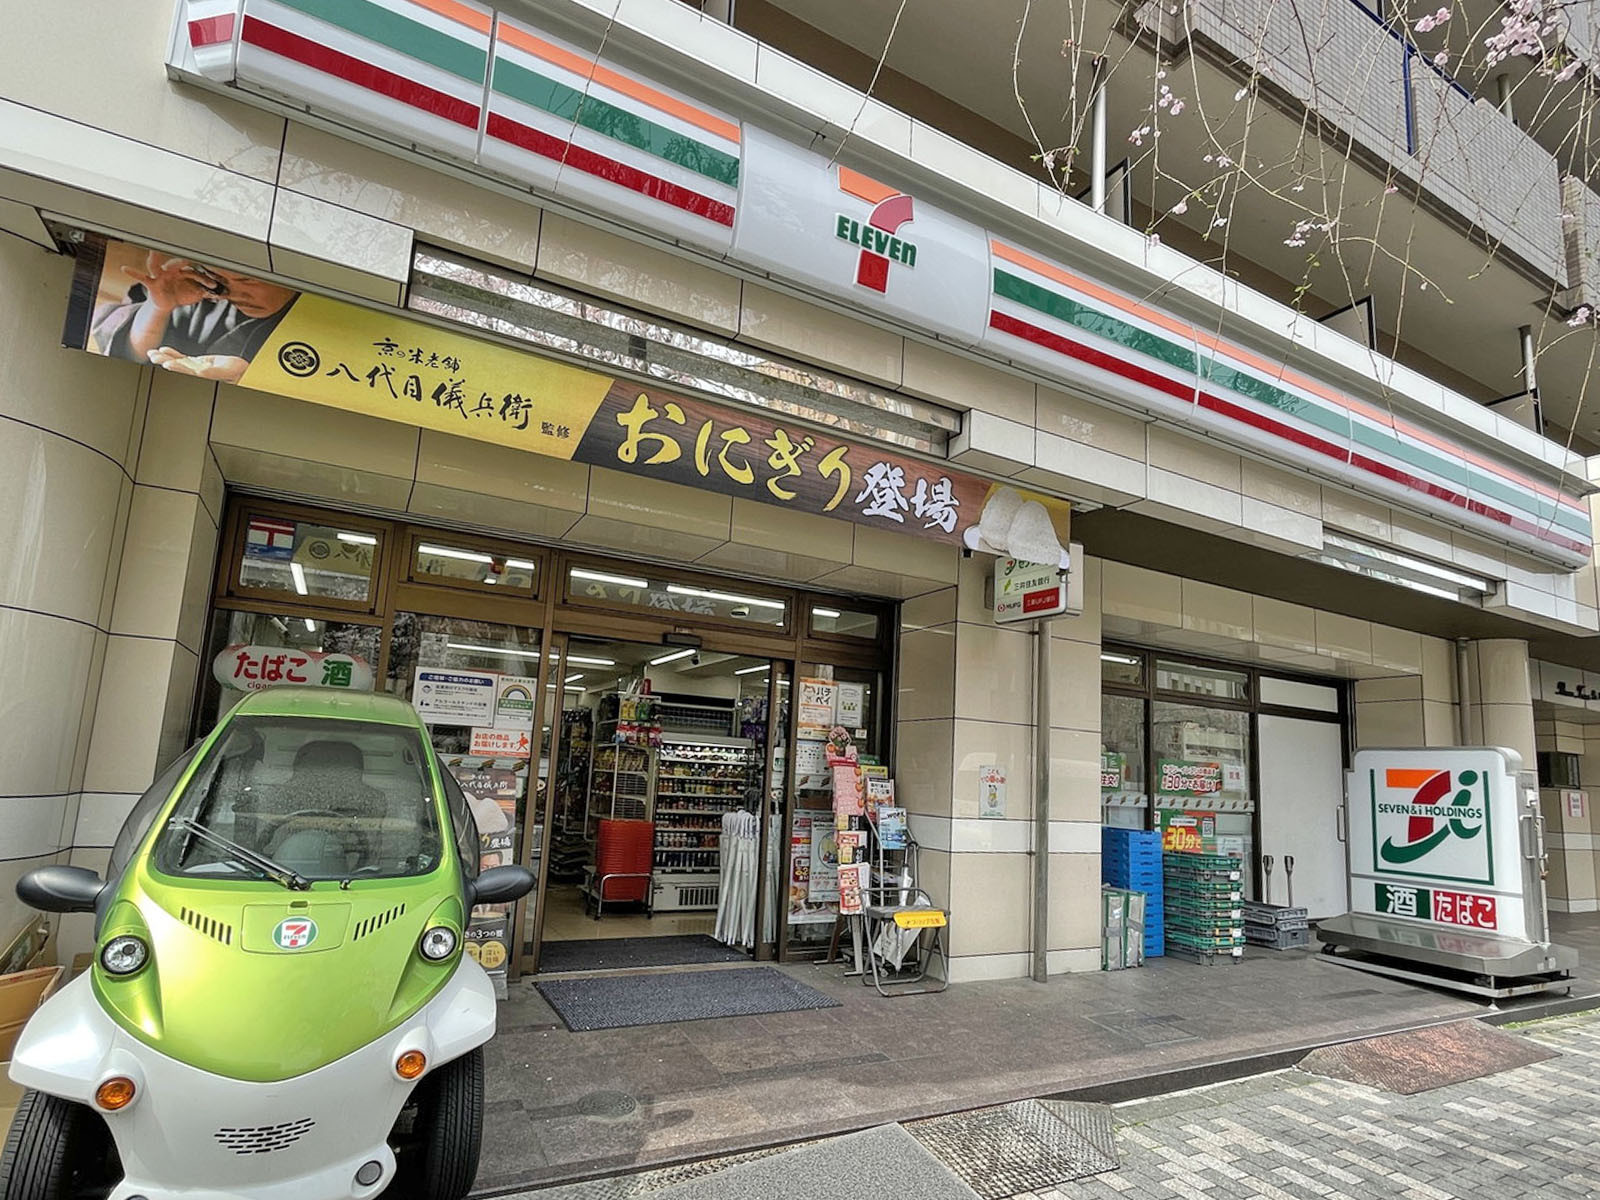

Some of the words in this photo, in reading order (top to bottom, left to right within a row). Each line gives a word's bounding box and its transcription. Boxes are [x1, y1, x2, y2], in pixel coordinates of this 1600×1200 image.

[836, 213, 918, 269] ELEVEN
[373, 337, 462, 373] 京の米老舗
[326, 362, 533, 430] 八代目儀兵衛
[541, 421, 570, 440] 監修
[616, 393, 960, 533] おにぎり登場
[1014, 575, 1050, 591] 三井住友銀行
[233, 651, 308, 682] たばこ
[321, 658, 353, 687] 酒
[1424, 804, 1483, 819] HOLDINGS
[1386, 885, 1418, 917] 酒
[1434, 892, 1495, 928] たばこ
